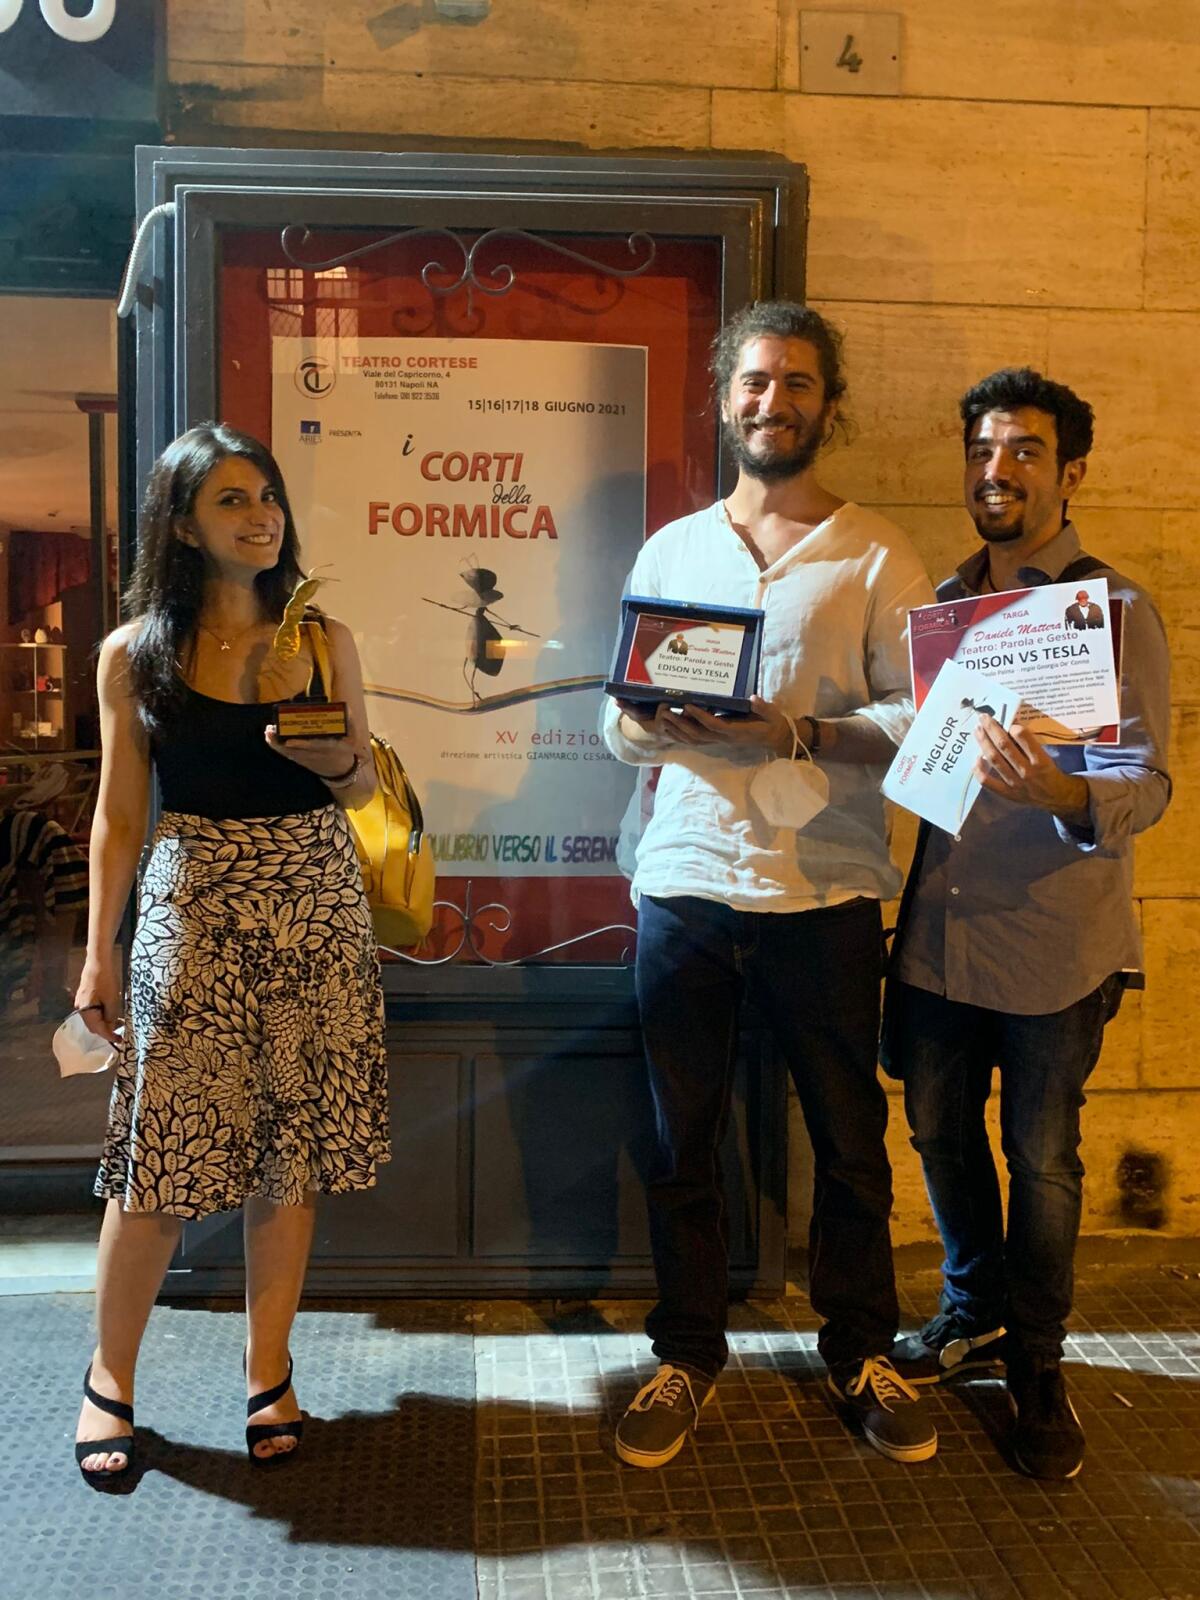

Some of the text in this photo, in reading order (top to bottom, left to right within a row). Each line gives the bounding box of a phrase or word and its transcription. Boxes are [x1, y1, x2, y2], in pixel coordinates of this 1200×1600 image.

[836, 34, 863, 73] 4
[341, 356, 478, 369] TEATRO CORTESE
[363, 370, 381, 379] Viale
[398, 371, 444, 380] Capricorno,
[400, 382, 424, 390] Napoli
[544, 401, 595, 414] GIUGNO
[597, 403, 626, 416] 2021
[328, 429, 362, 437] PRESENTA
[420, 451, 524, 482] CORTI
[492, 483, 533, 505] della
[368, 501, 558, 539] FORMICA
[1002, 610, 1029, 620] TARGA
[974, 622, 1061, 643] Daniele Mattera
[961, 642, 998, 656] Teatro:
[1000, 637, 1034, 650] Parola
[1046, 632, 1079, 643] Gesto
[957, 643, 1090, 671] DISON VS TESLA
[657, 663, 730, 679] EDISON VS TESLA
[495, 731, 518, 744] XV
[922, 716, 958, 775] MIGLIOR
[440, 751, 480, 759] direzione
[484, 751, 522, 759] artistica
[526, 752, 579, 760] GIANMARCO
[941, 731, 971, 775] REGIA
[492, 834, 541, 863] VERSO
[544, 835, 558, 863] IL
